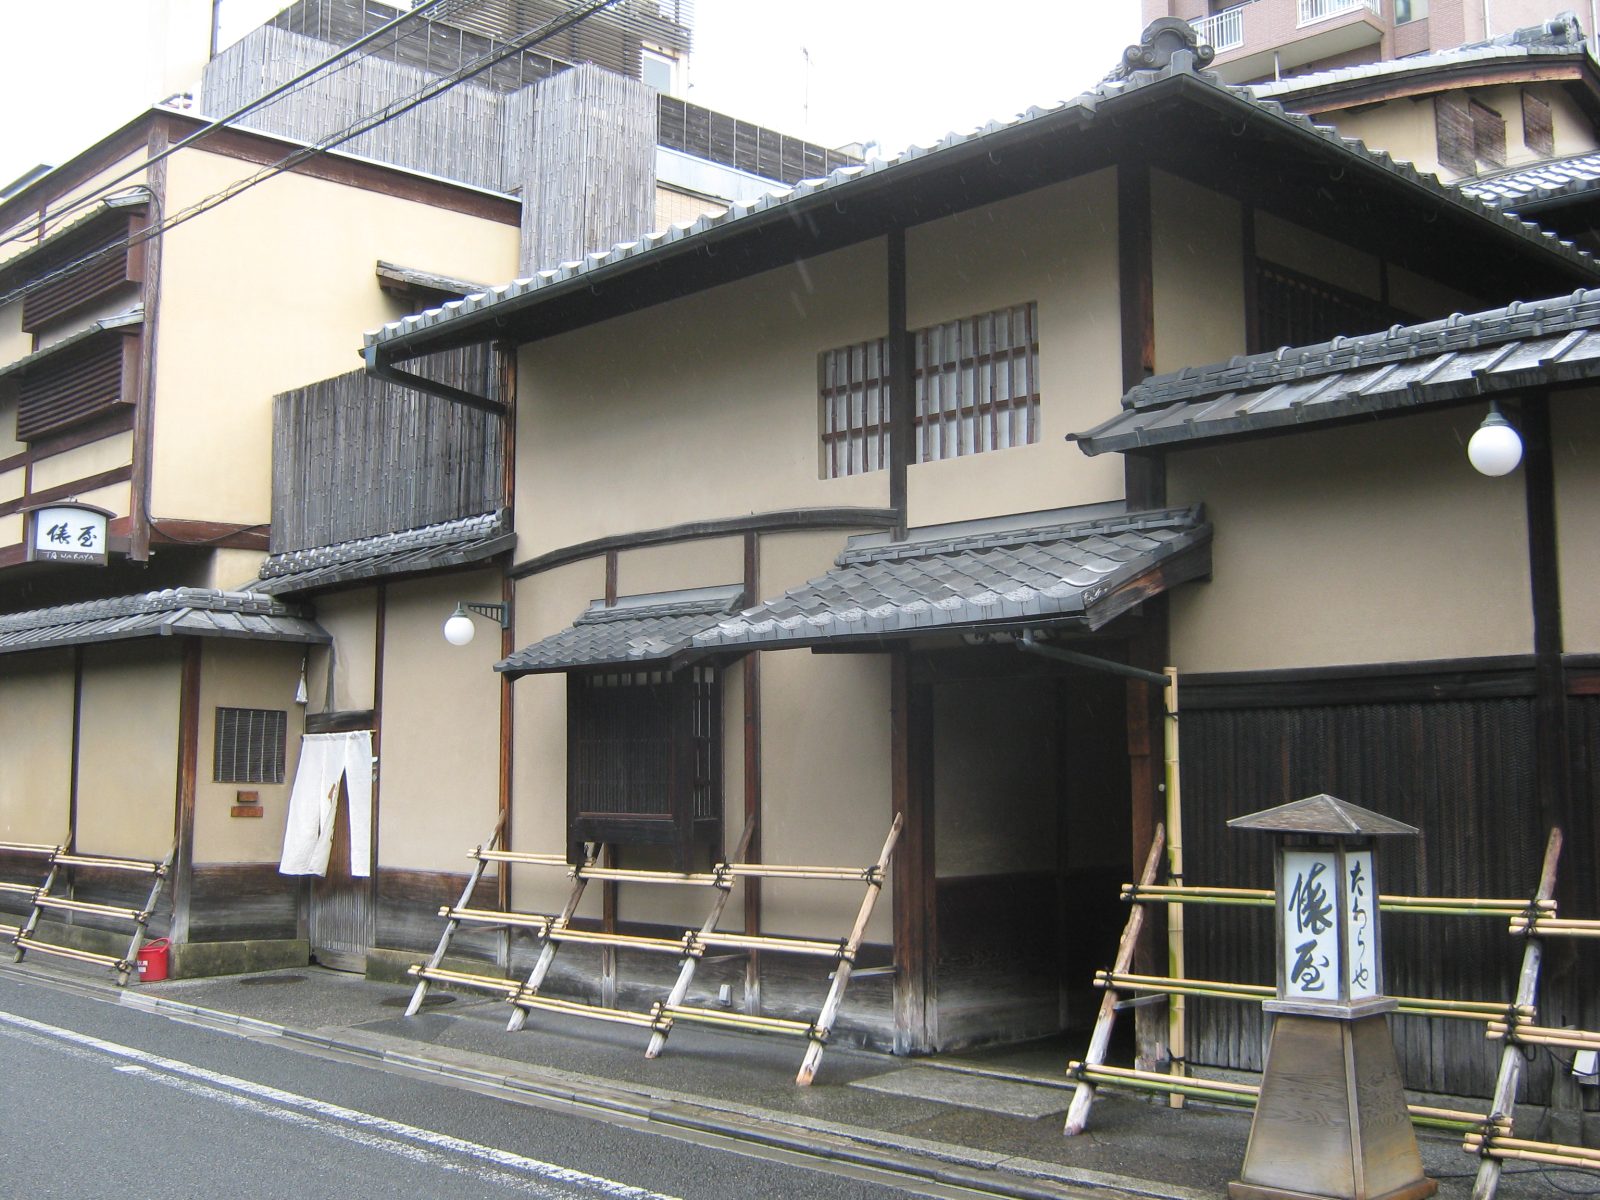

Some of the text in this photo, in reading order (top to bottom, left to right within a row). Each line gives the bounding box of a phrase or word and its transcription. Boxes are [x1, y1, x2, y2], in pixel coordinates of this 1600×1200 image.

[46, 522, 97, 548] 俵屋
[1288, 862, 1334, 992] 俵屋
[1350, 860, 1369, 990] たわらや
